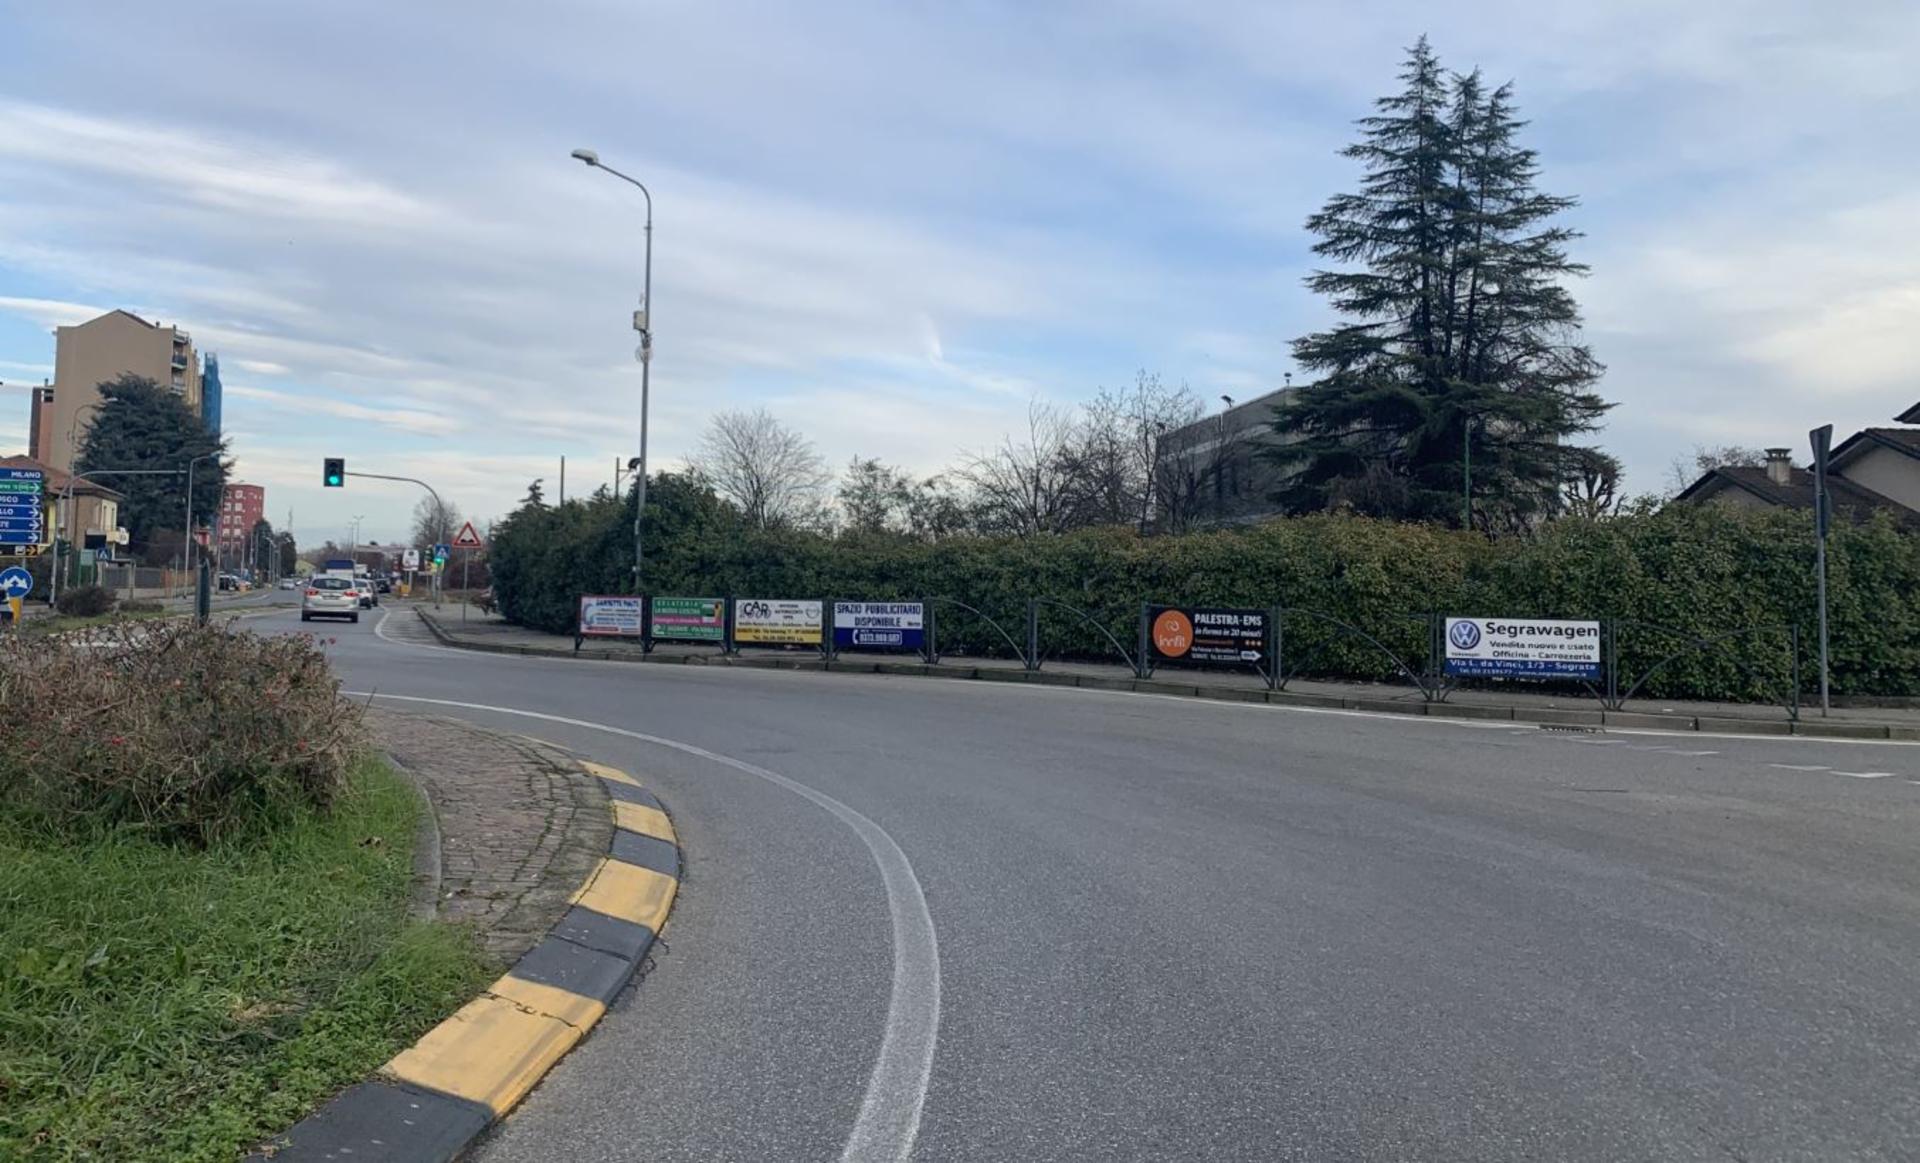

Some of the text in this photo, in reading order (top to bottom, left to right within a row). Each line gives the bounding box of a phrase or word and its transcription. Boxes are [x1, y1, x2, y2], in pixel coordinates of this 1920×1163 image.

[837, 604, 921, 615] SPAZIO PUBBLICITARIO
[855, 616, 901, 626] DISPONIBILE
[1230, 628, 1240, 636] 20
[1485, 621, 1598, 640] Segrawagen
[1490, 640, 1526, 649] Vendita
[1567, 643, 1595, 651] usato
[1492, 650, 1529, 659] Officina
[1538, 651, 1592, 660] Carrozzeria
[1449, 659, 1466, 667] Via
[1495, 660, 1524, 669] Vinci,
[1527, 661, 1545, 669] 1/3
[1555, 662, 1596, 671] Segrate
